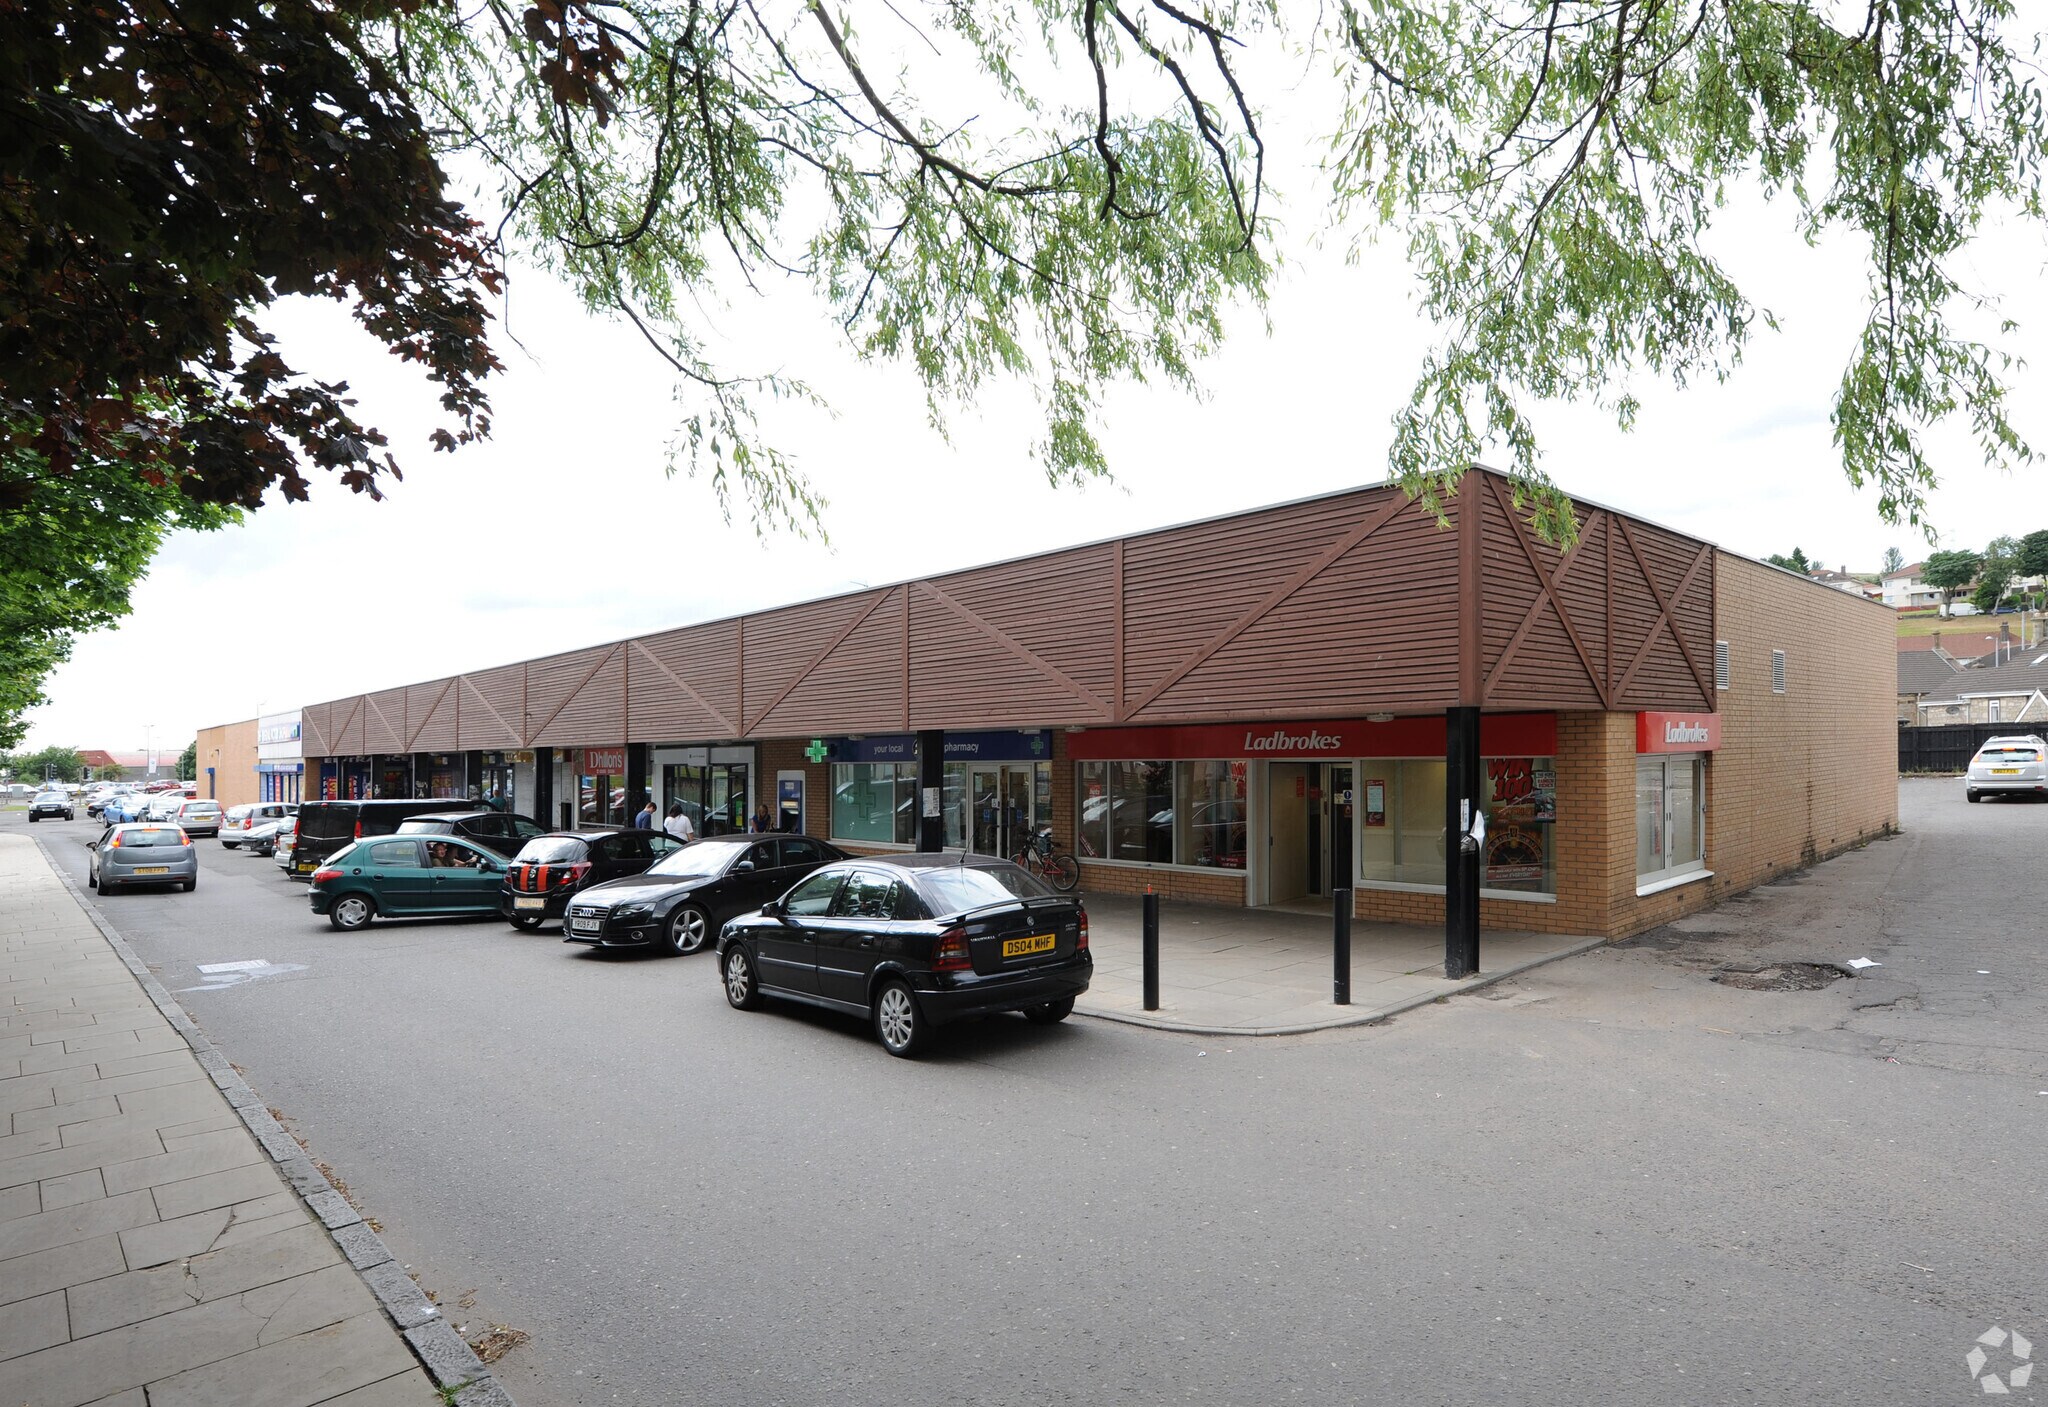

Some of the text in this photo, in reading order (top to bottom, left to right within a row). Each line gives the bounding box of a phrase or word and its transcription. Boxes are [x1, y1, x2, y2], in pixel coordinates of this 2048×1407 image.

[1244, 730, 1342, 750] Ladbrokes
[1665, 721, 1709, 743] Ladbrokes
[874, 744, 904, 754] your local
[944, 742, 979, 753] pharmacy
[590, 751, 623, 768] Dhillon's
[1487, 757, 1534, 780] WIN
[1007, 936, 1052, 954] DS04 MHF
